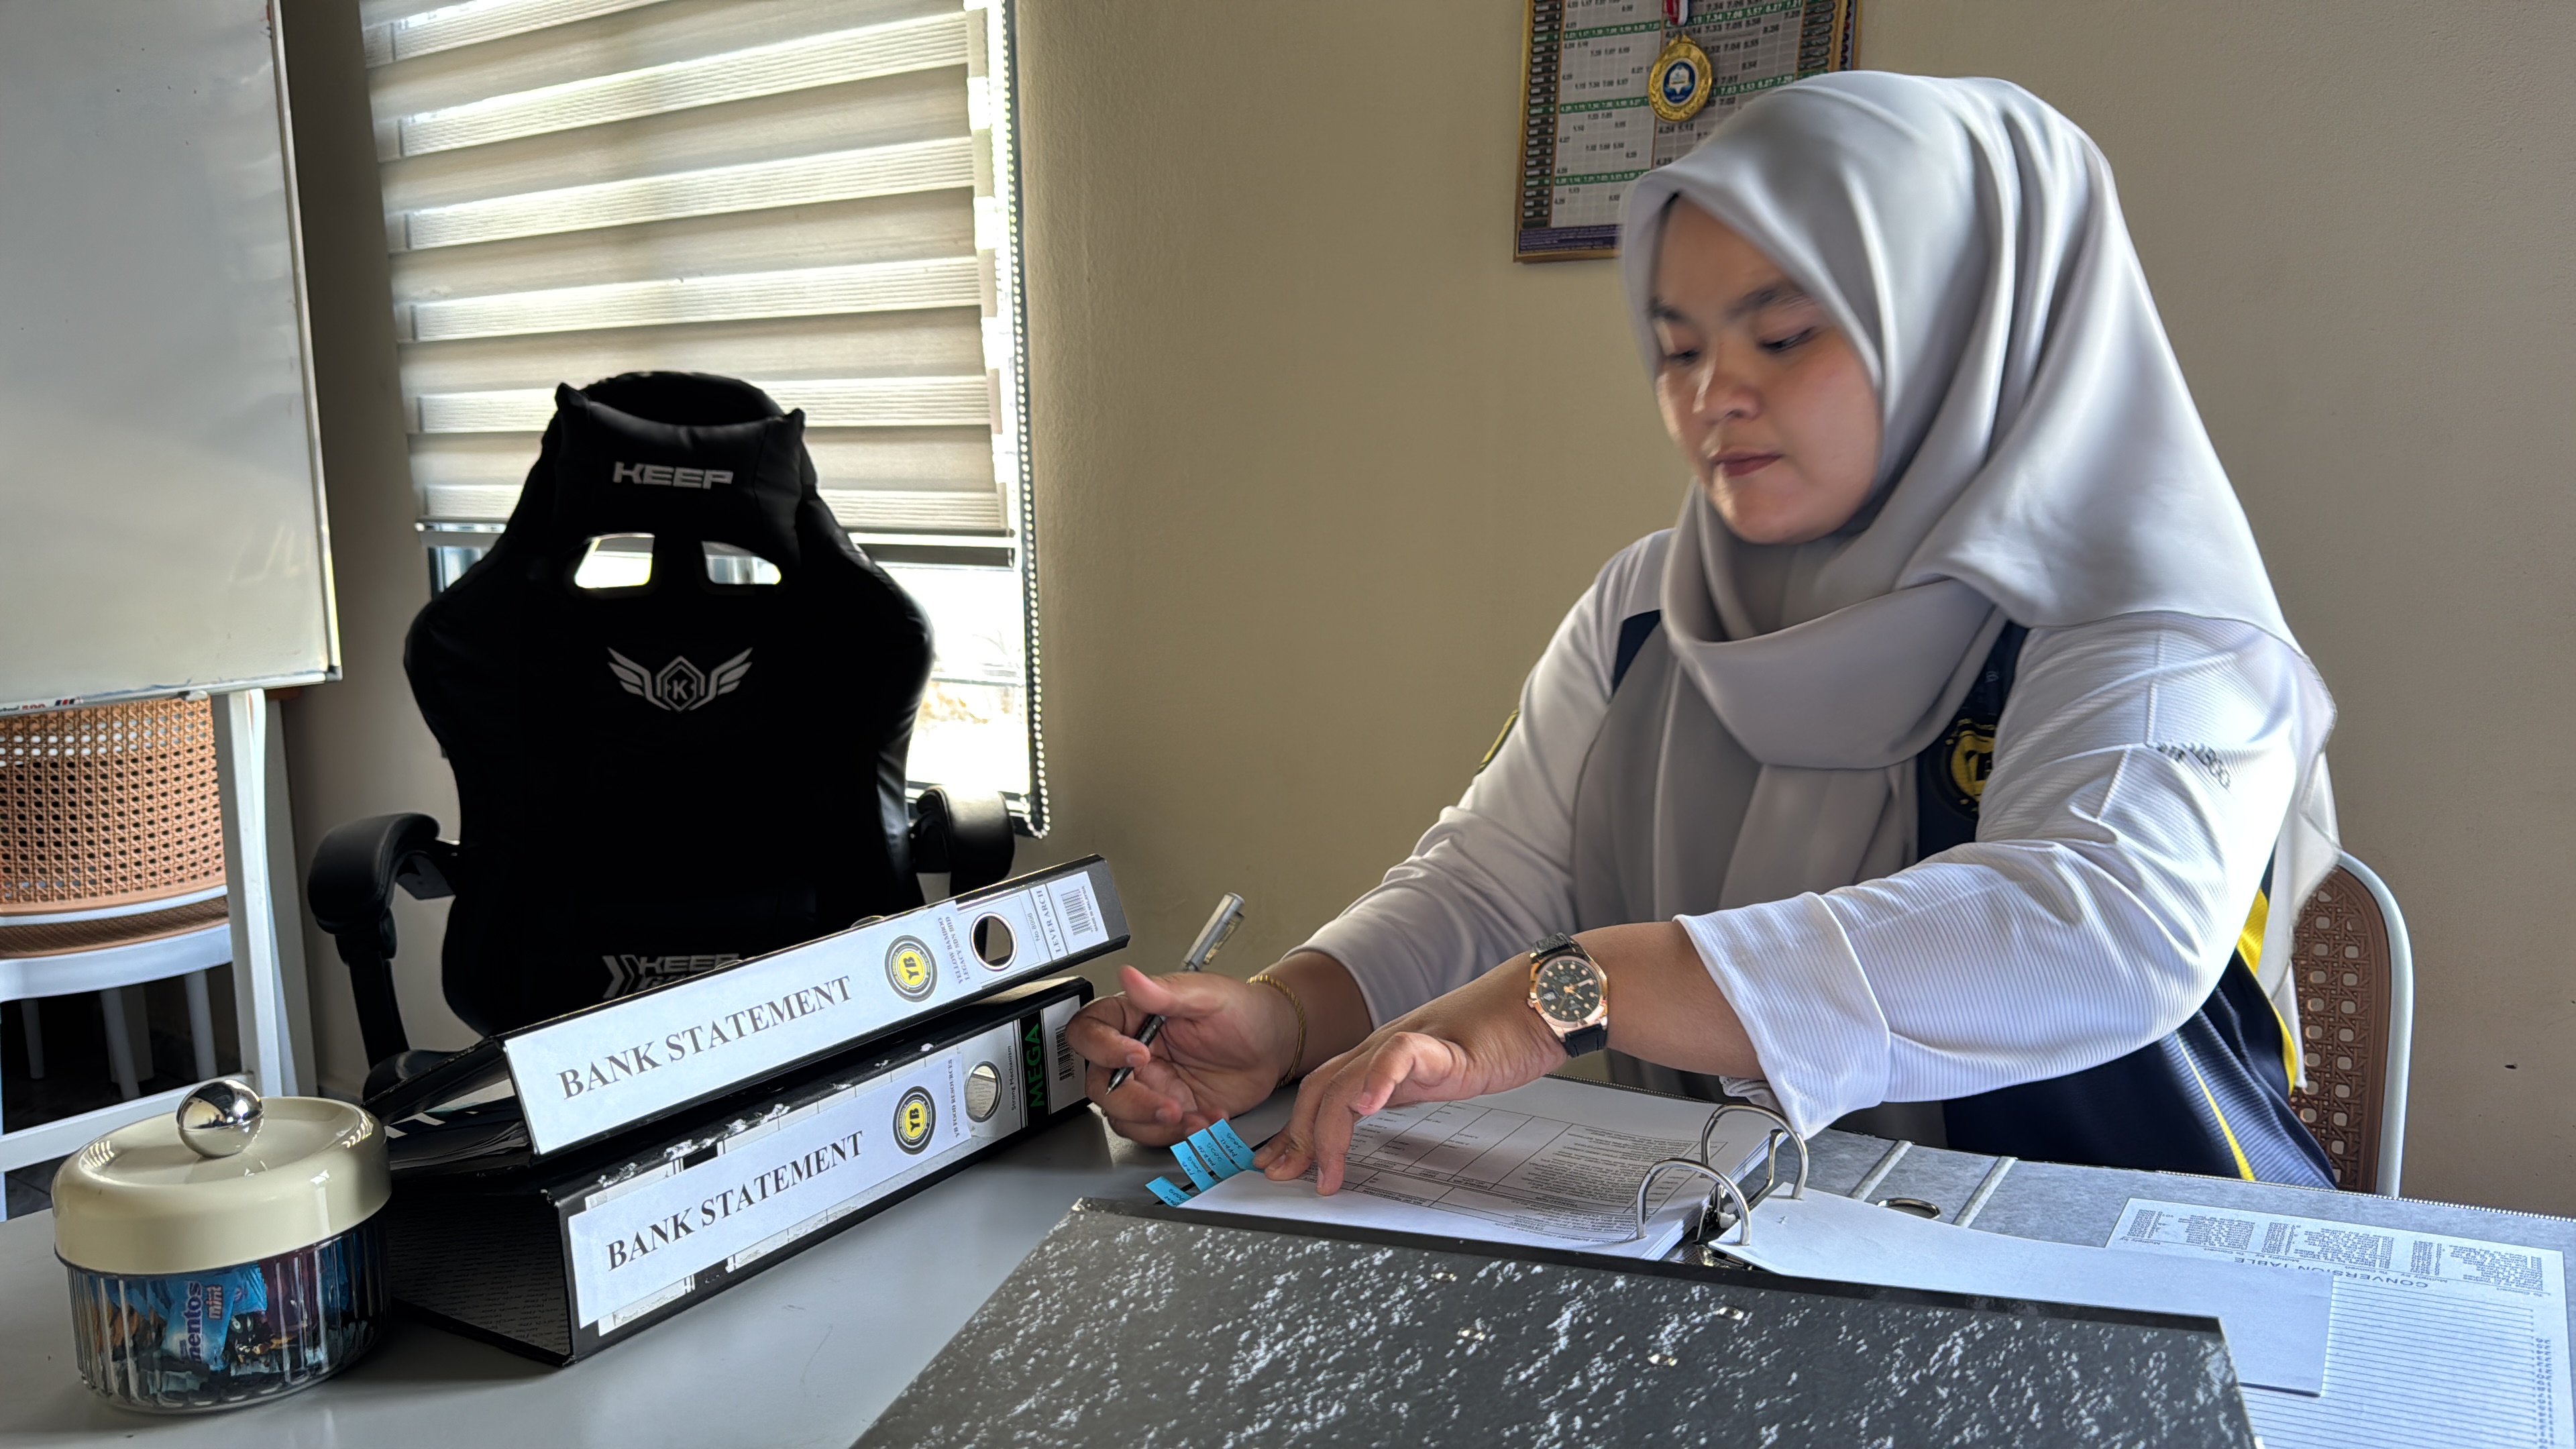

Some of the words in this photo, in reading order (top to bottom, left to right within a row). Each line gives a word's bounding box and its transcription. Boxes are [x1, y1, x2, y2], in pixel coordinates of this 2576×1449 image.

[612, 462, 734, 489] KEEP
[1036, 890, 1051, 918] ARCH
[938, 917, 953, 950] BAMBOO
[945, 916, 955, 932] BHD
[1046, 919, 1061, 953] LEVER
[951, 933, 960, 949] SDN
[902, 955, 922, 982] YB
[949, 952, 963, 984] YELLOW
[956, 949, 970, 981] LEGACY
[556, 1041, 661, 1100] BANK
[665, 975, 852, 1063] STATEMENT
[1008, 1045, 1016, 1085] Mechanism
[1025, 1023, 1045, 1107] MEGA
[948, 1059, 956, 1104] RESOURCES
[910, 1108, 927, 1132] YB
[606, 1208, 696, 1272] BANK
[701, 1130, 863, 1228] STATEMENT
